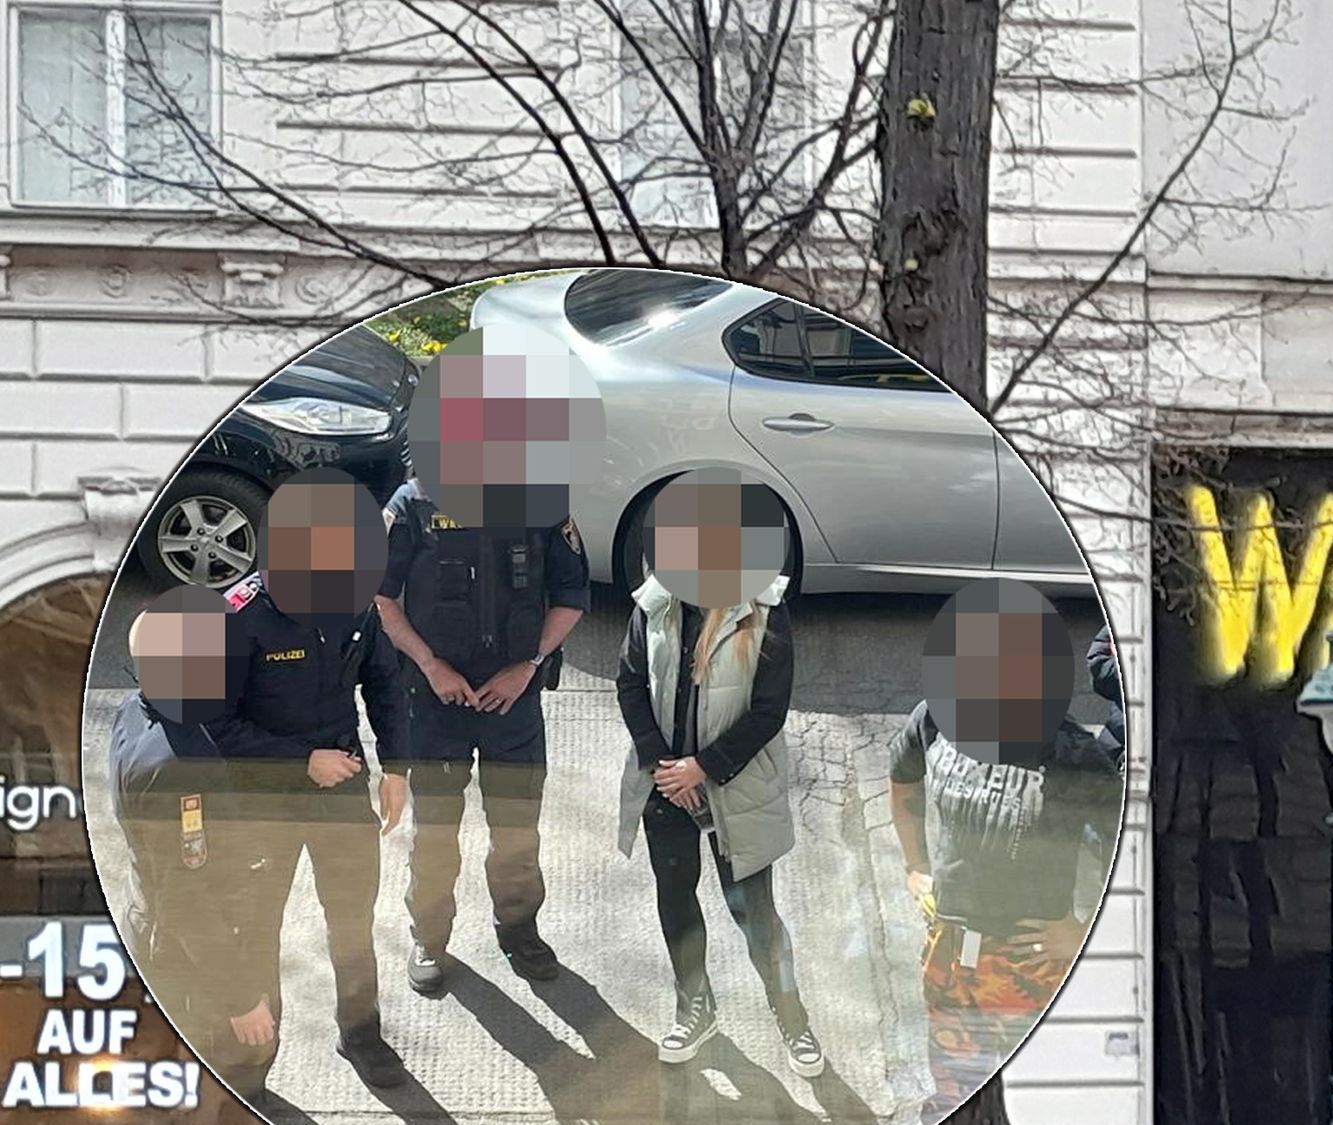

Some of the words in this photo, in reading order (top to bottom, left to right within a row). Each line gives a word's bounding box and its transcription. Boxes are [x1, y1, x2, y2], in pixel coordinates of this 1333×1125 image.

[0, 921, 152, 1003] -15
[37, 1009, 137, 1054] AUF
[2, 1061, 200, 1109] ALLES!
